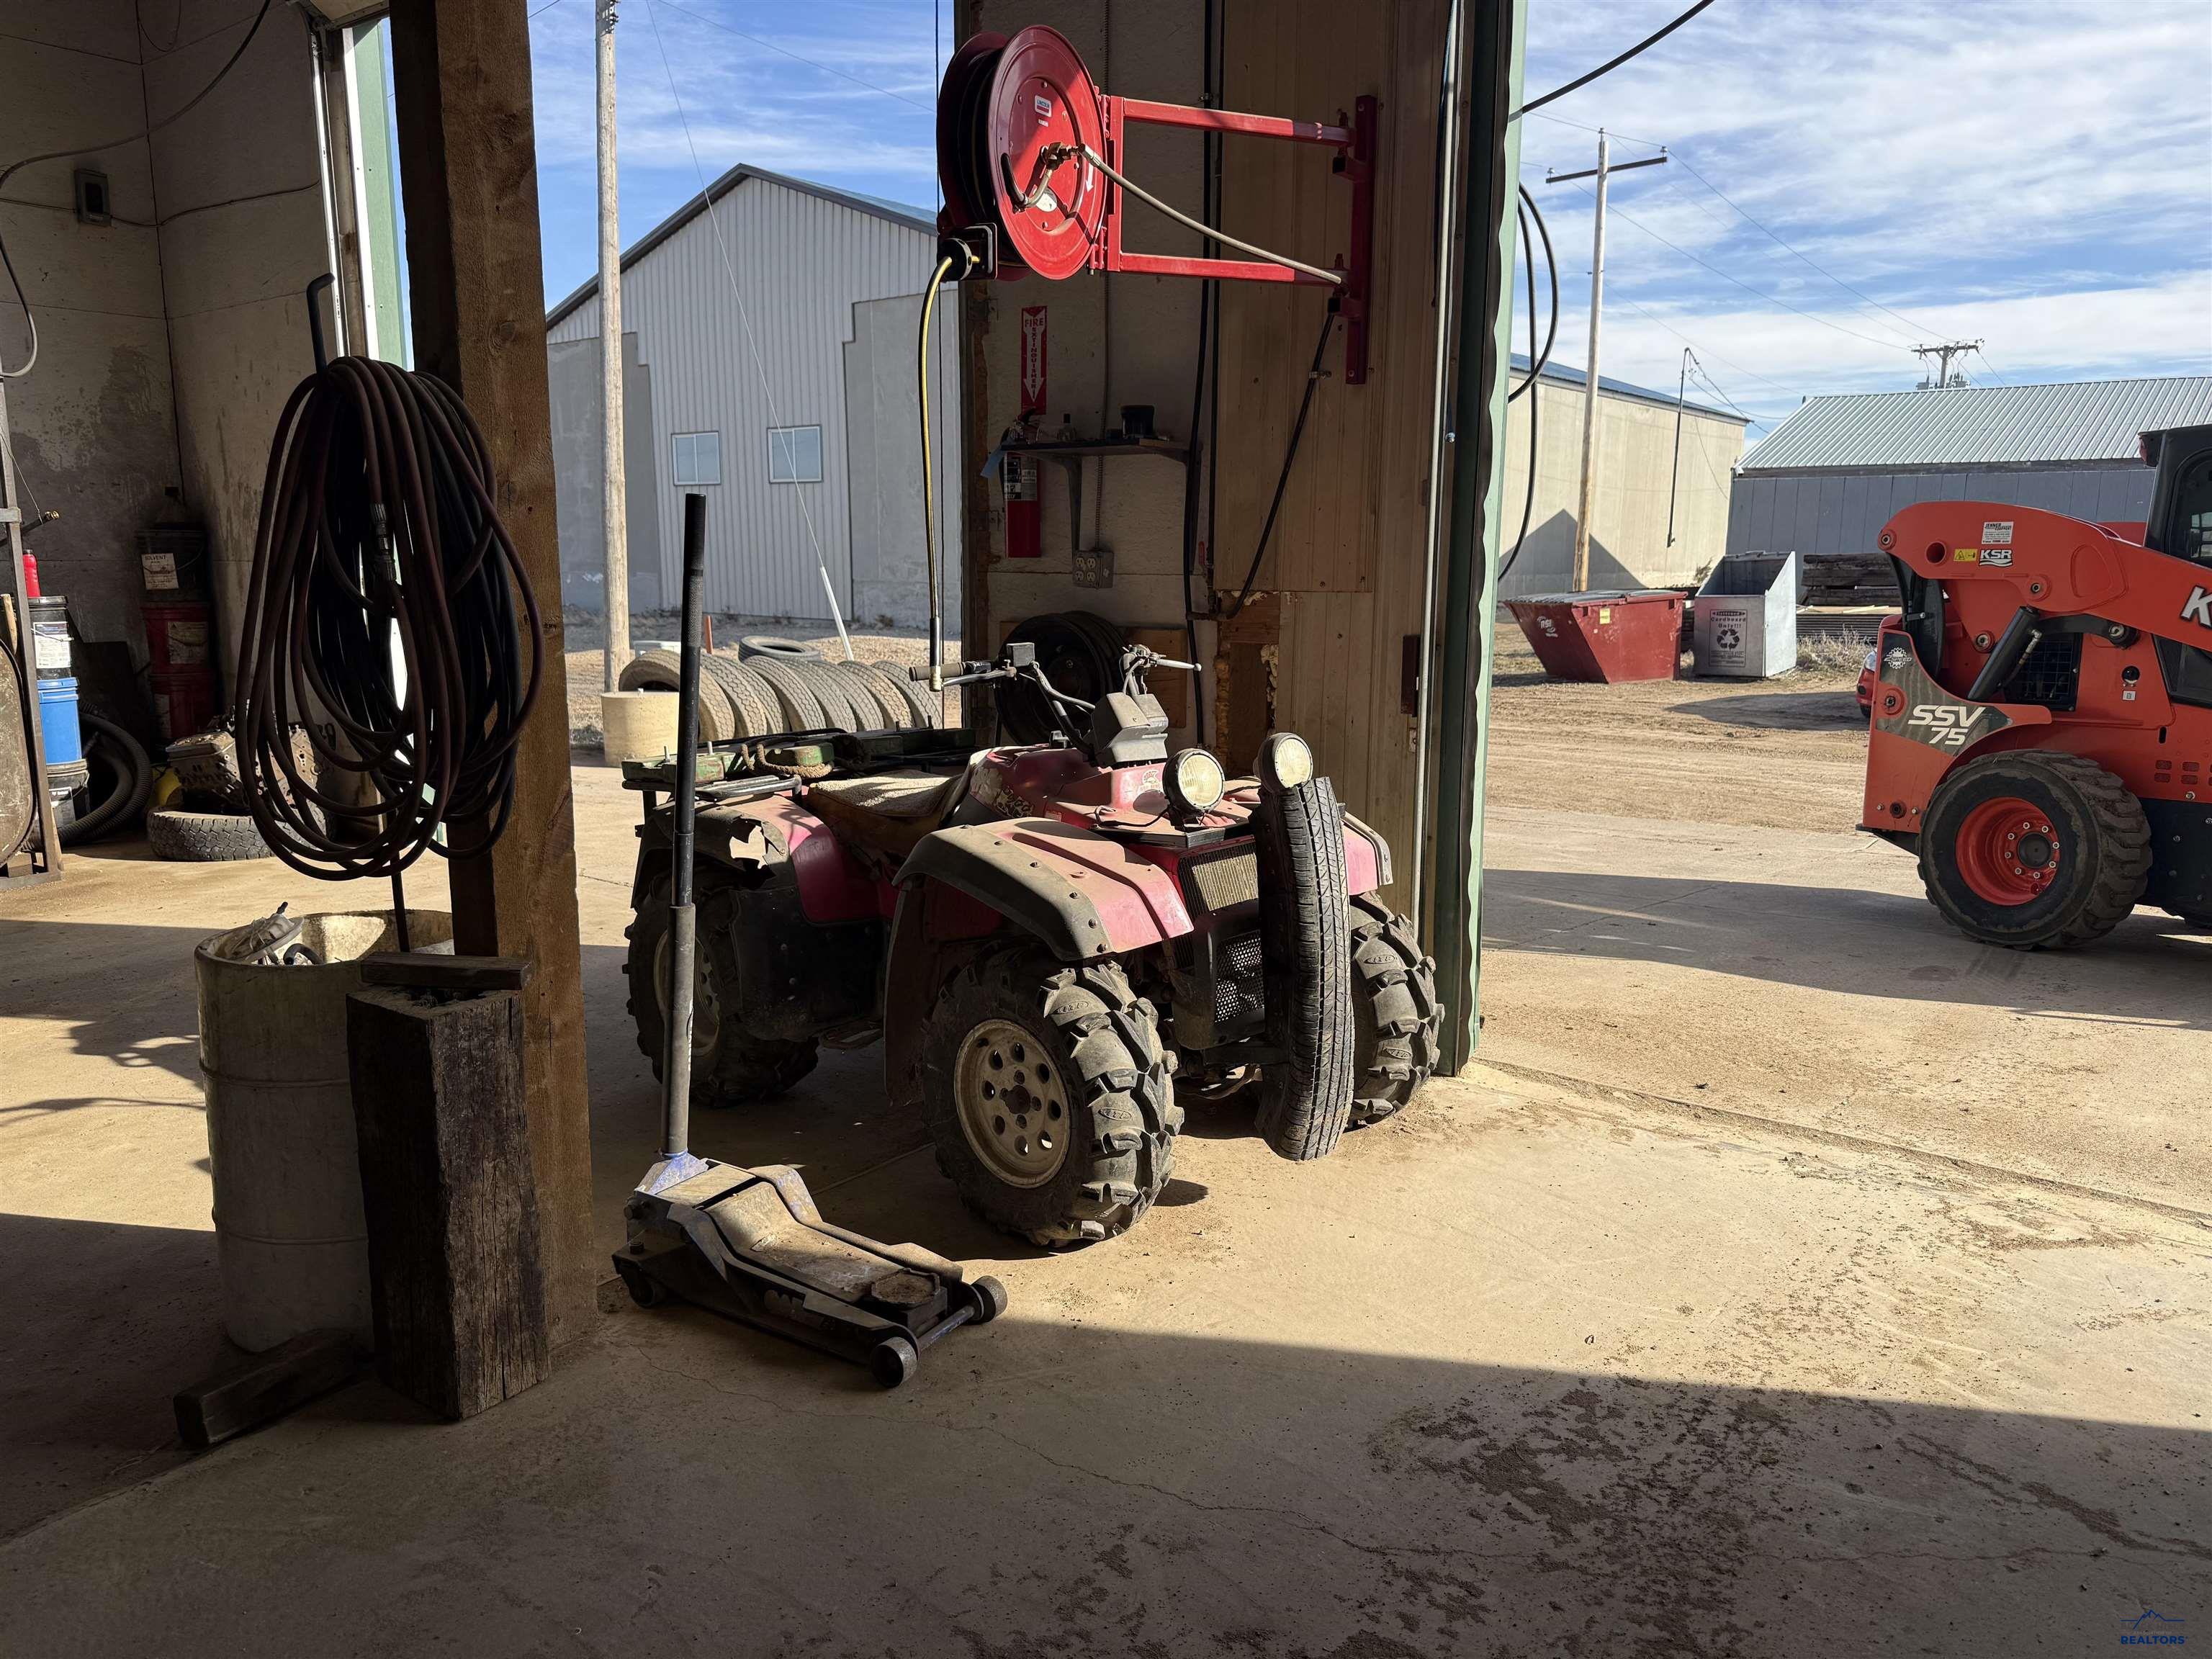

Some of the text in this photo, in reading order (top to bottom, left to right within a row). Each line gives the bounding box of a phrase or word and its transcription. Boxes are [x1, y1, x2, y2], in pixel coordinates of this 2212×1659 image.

[1025, 318, 1043, 327] FIRE
[1980, 549, 2012, 559] KSR
[1908, 705, 1986, 727] SSV
[1929, 728, 1969, 745] 75
